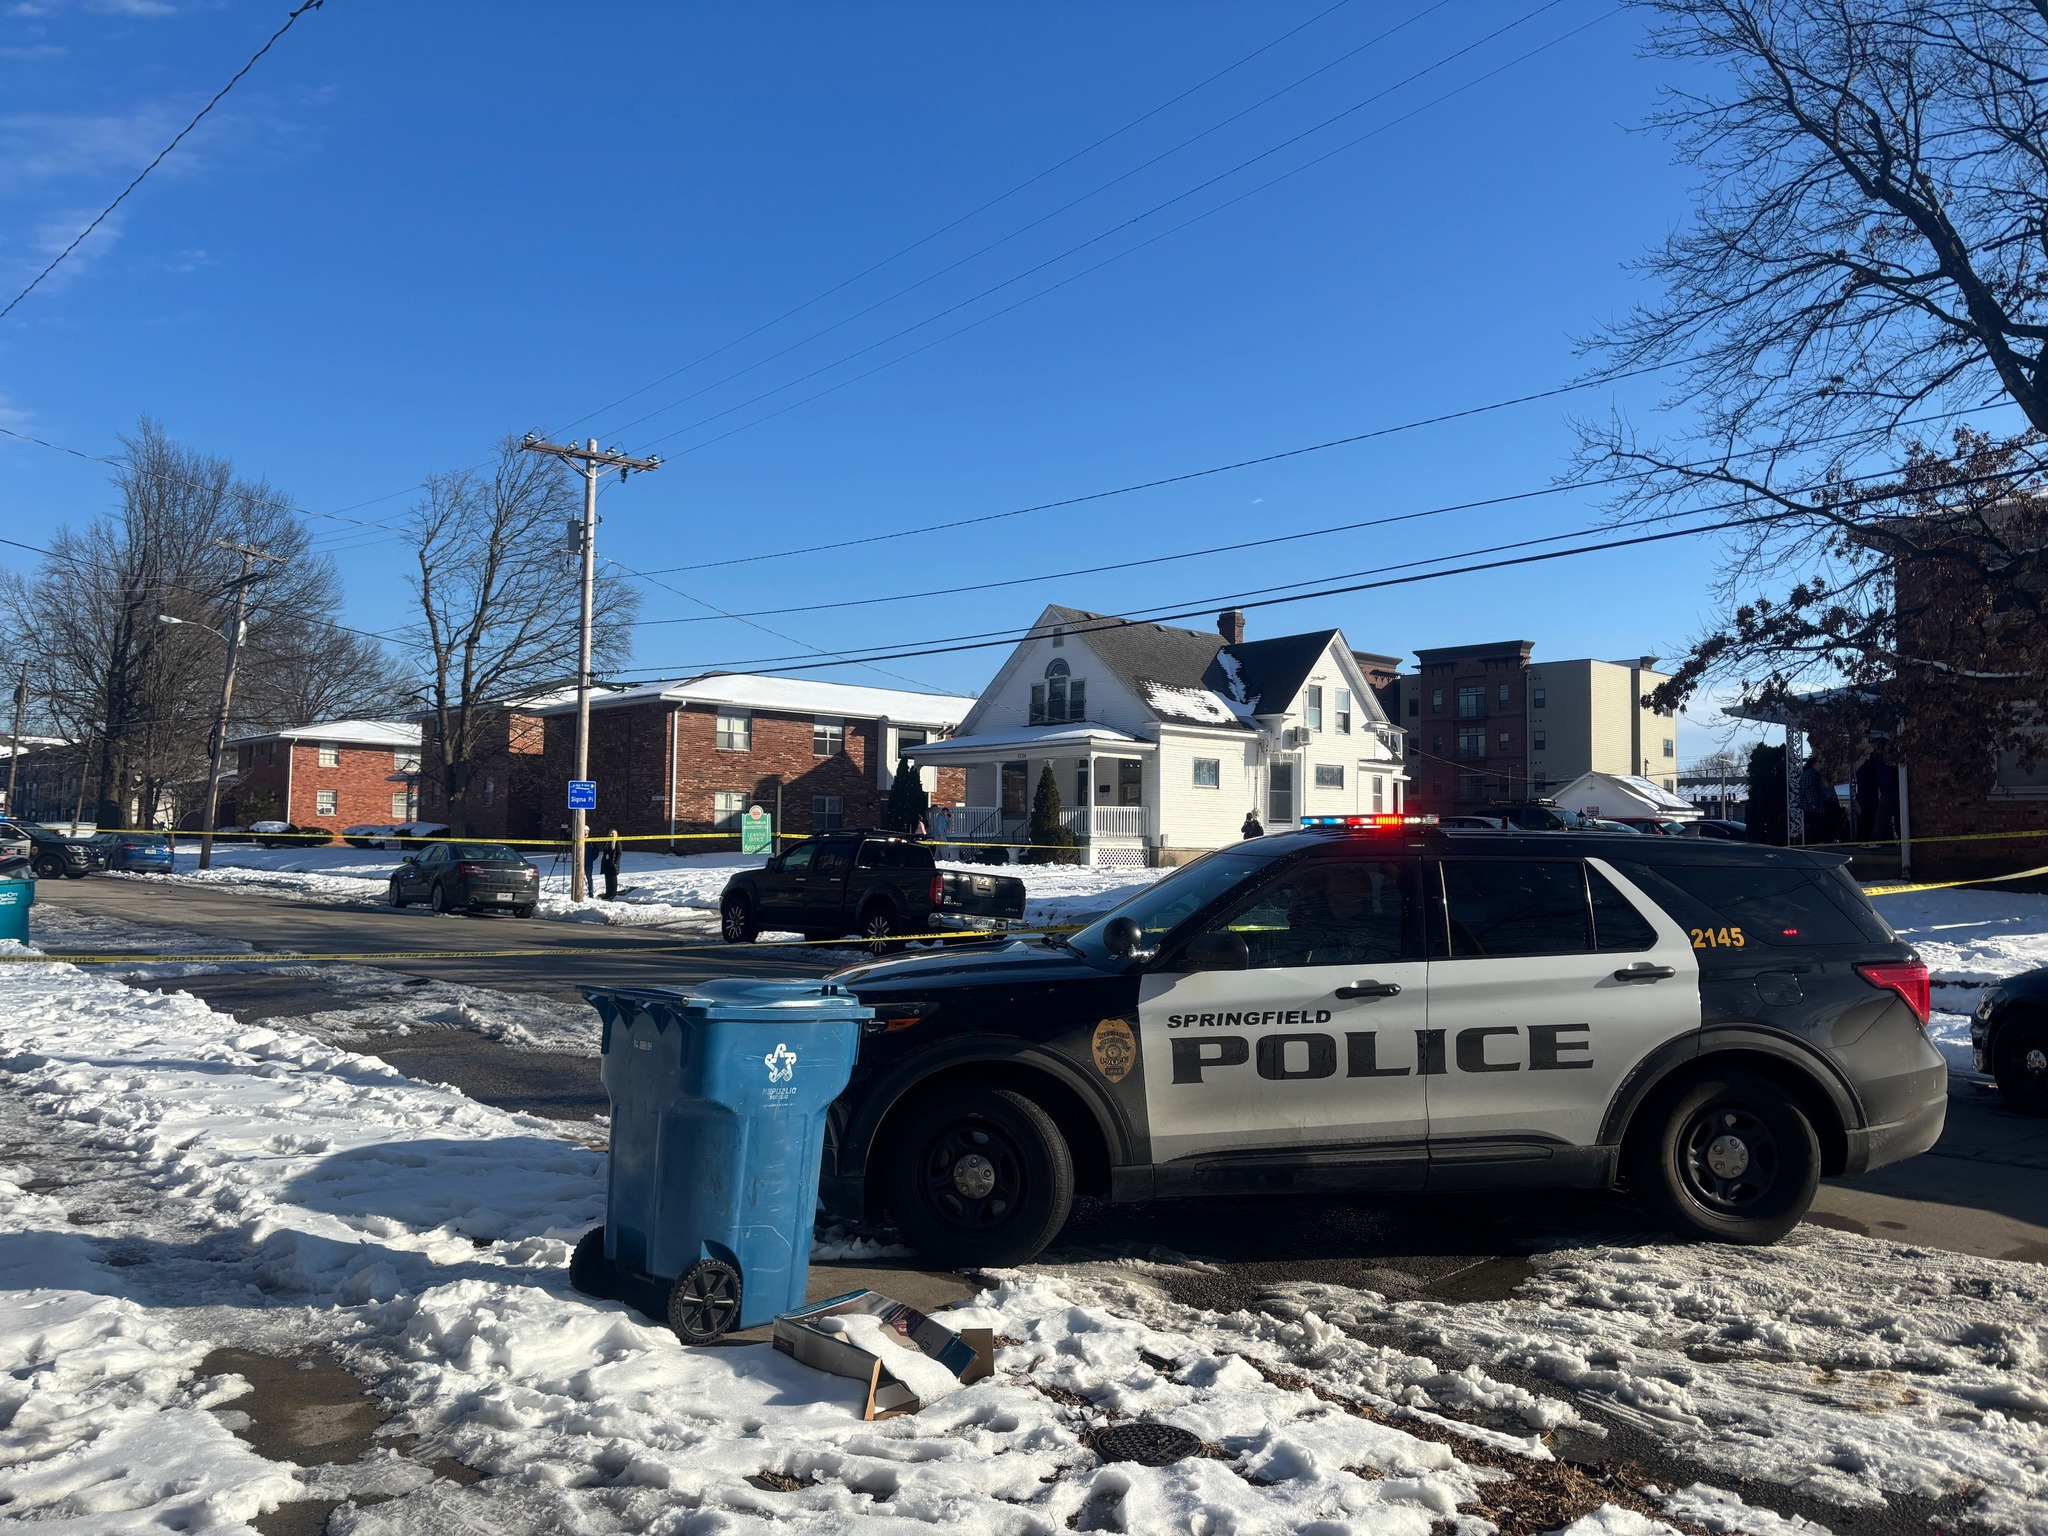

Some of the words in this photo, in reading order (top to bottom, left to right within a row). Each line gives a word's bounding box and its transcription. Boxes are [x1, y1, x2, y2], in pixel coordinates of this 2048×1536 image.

[1690, 927, 1745, 949] 2145
[1166, 1009, 1332, 1029] SPRINGFIELD
[1168, 1023, 1595, 1085] POLICE
